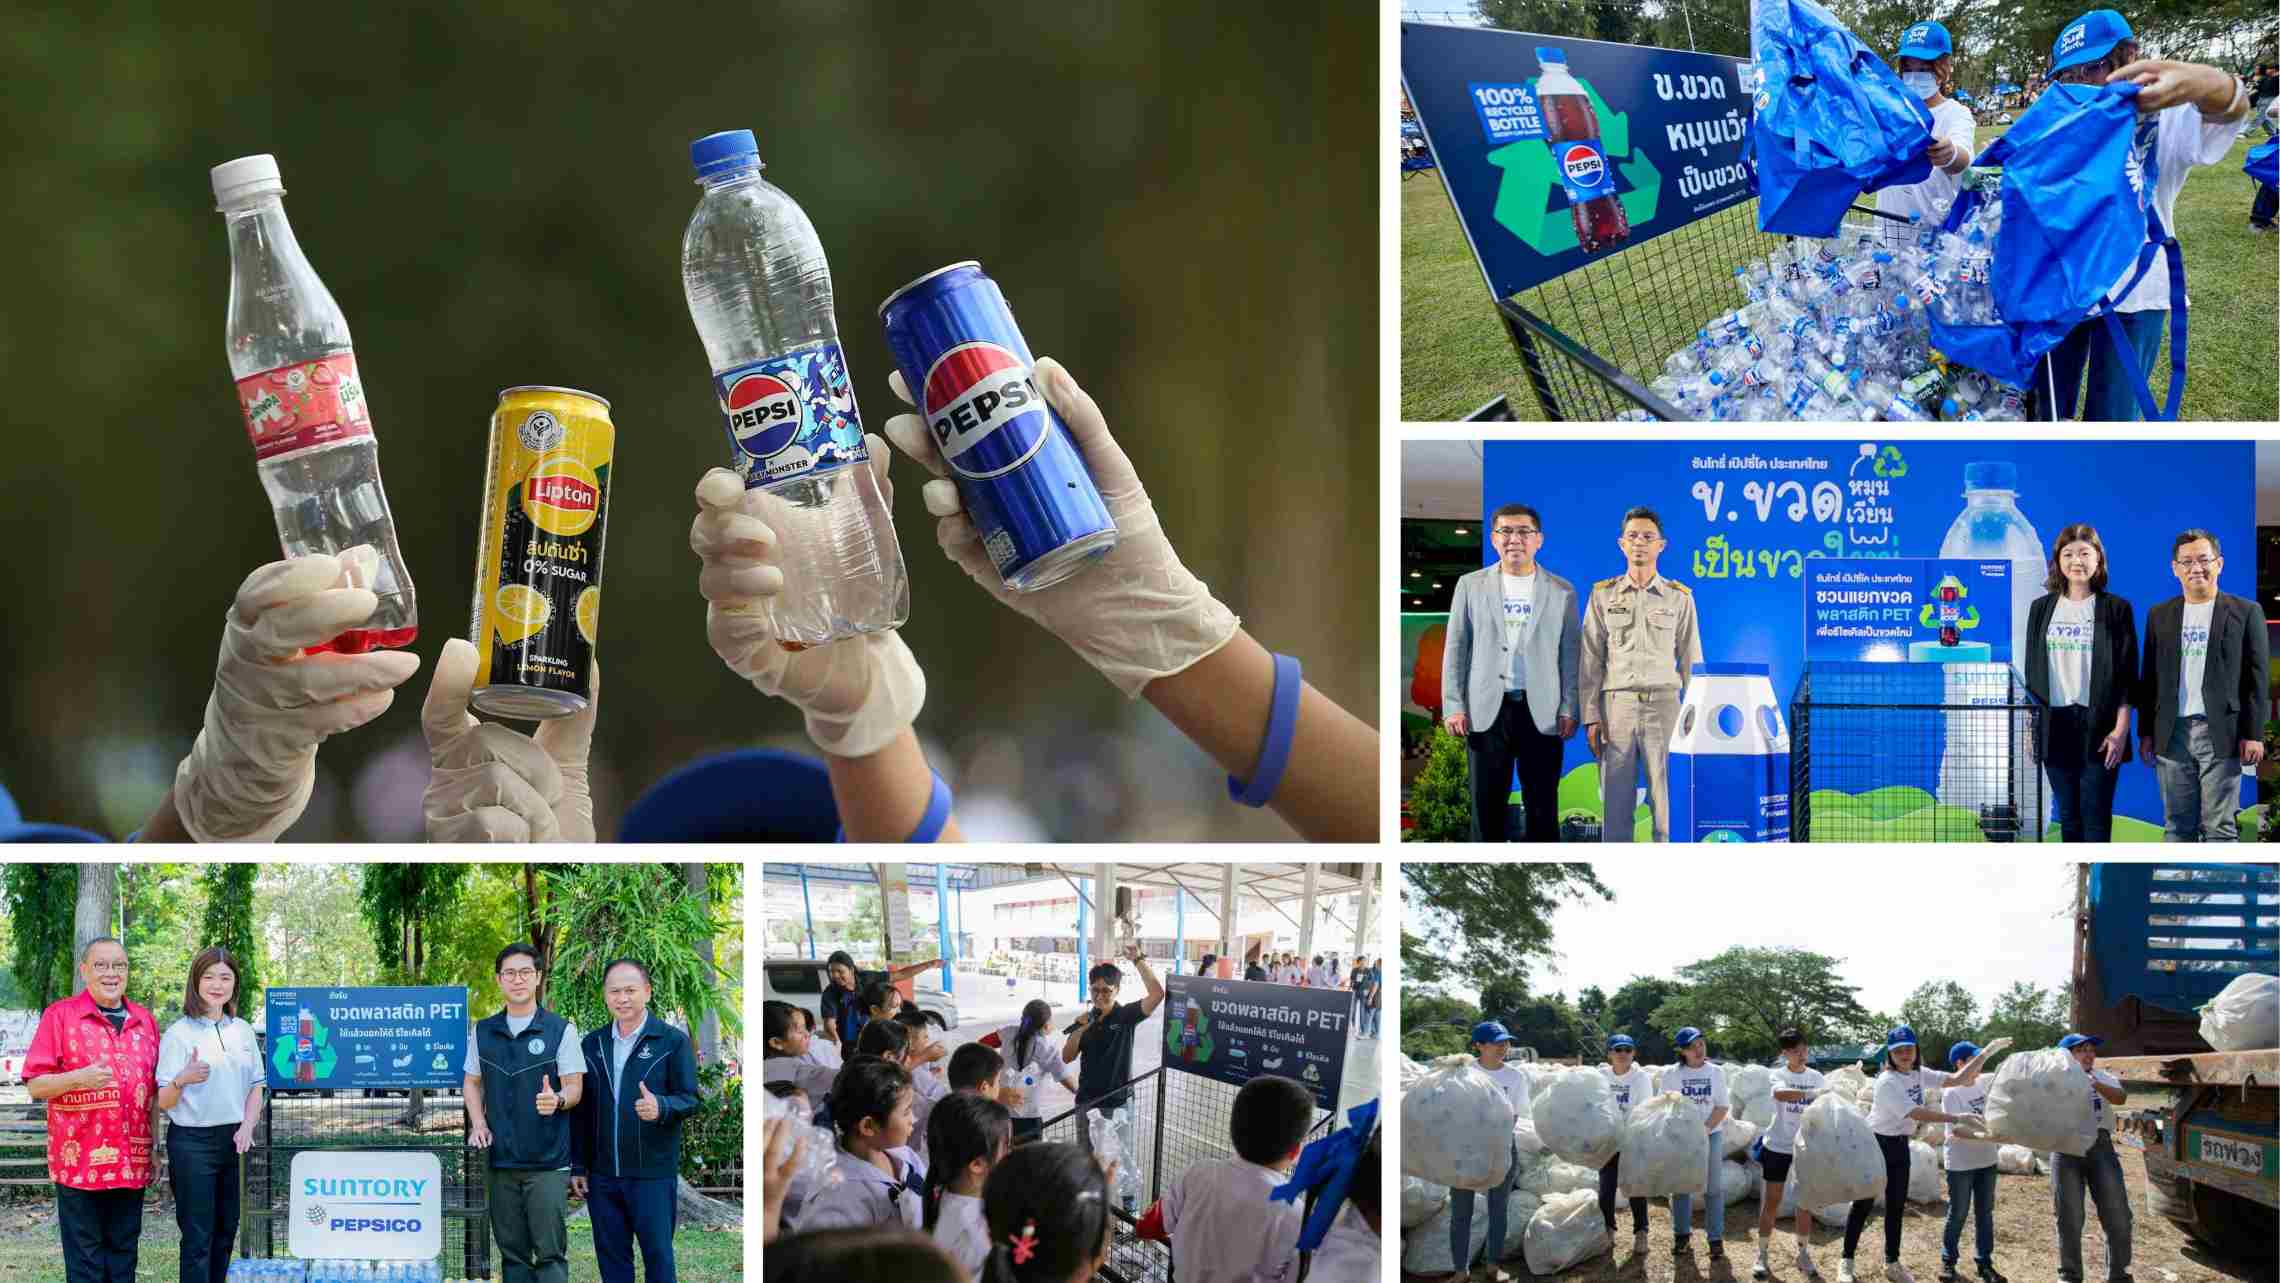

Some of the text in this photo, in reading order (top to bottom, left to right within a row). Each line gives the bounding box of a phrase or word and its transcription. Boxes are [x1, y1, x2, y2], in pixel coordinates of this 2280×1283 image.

[1475, 88, 1534, 105] 100%
[1654, 73, 1727, 101] ข.ขวด
[1488, 116, 1541, 131] BOTTLE
[1568, 160, 1601, 173] PEPSI
[732, 399, 797, 431] PEPSI
[934, 377, 1040, 447] PEPSI
[1770, 456, 1828, 469] ประเทศไทย
[535, 481, 593, 506] Lipton
[1692, 481, 1843, 523] ข.ขวด
[1848, 480, 1890, 506] หมุน
[1846, 501, 1894, 524] เวียน
[523, 559, 587, 583] 0% SUGAR
[1816, 591, 1912, 604] ชวนแยกขวด
[1816, 606, 1912, 621] พลาสติก PET
[517, 663, 546, 674] LEMON
[529, 653, 568, 667] SPARKLING
[329, 1003, 463, 1020] ขวดพลาสติก PET
[1210, 999, 1301, 1026] ขวดพลาสติก
[1306, 1009, 1346, 1032] PET
[2202, 1140, 2262, 1168] รถพ่วง
[304, 1178, 428, 1198] SUNTORY
[331, 1218, 422, 1233] PEPSICO
